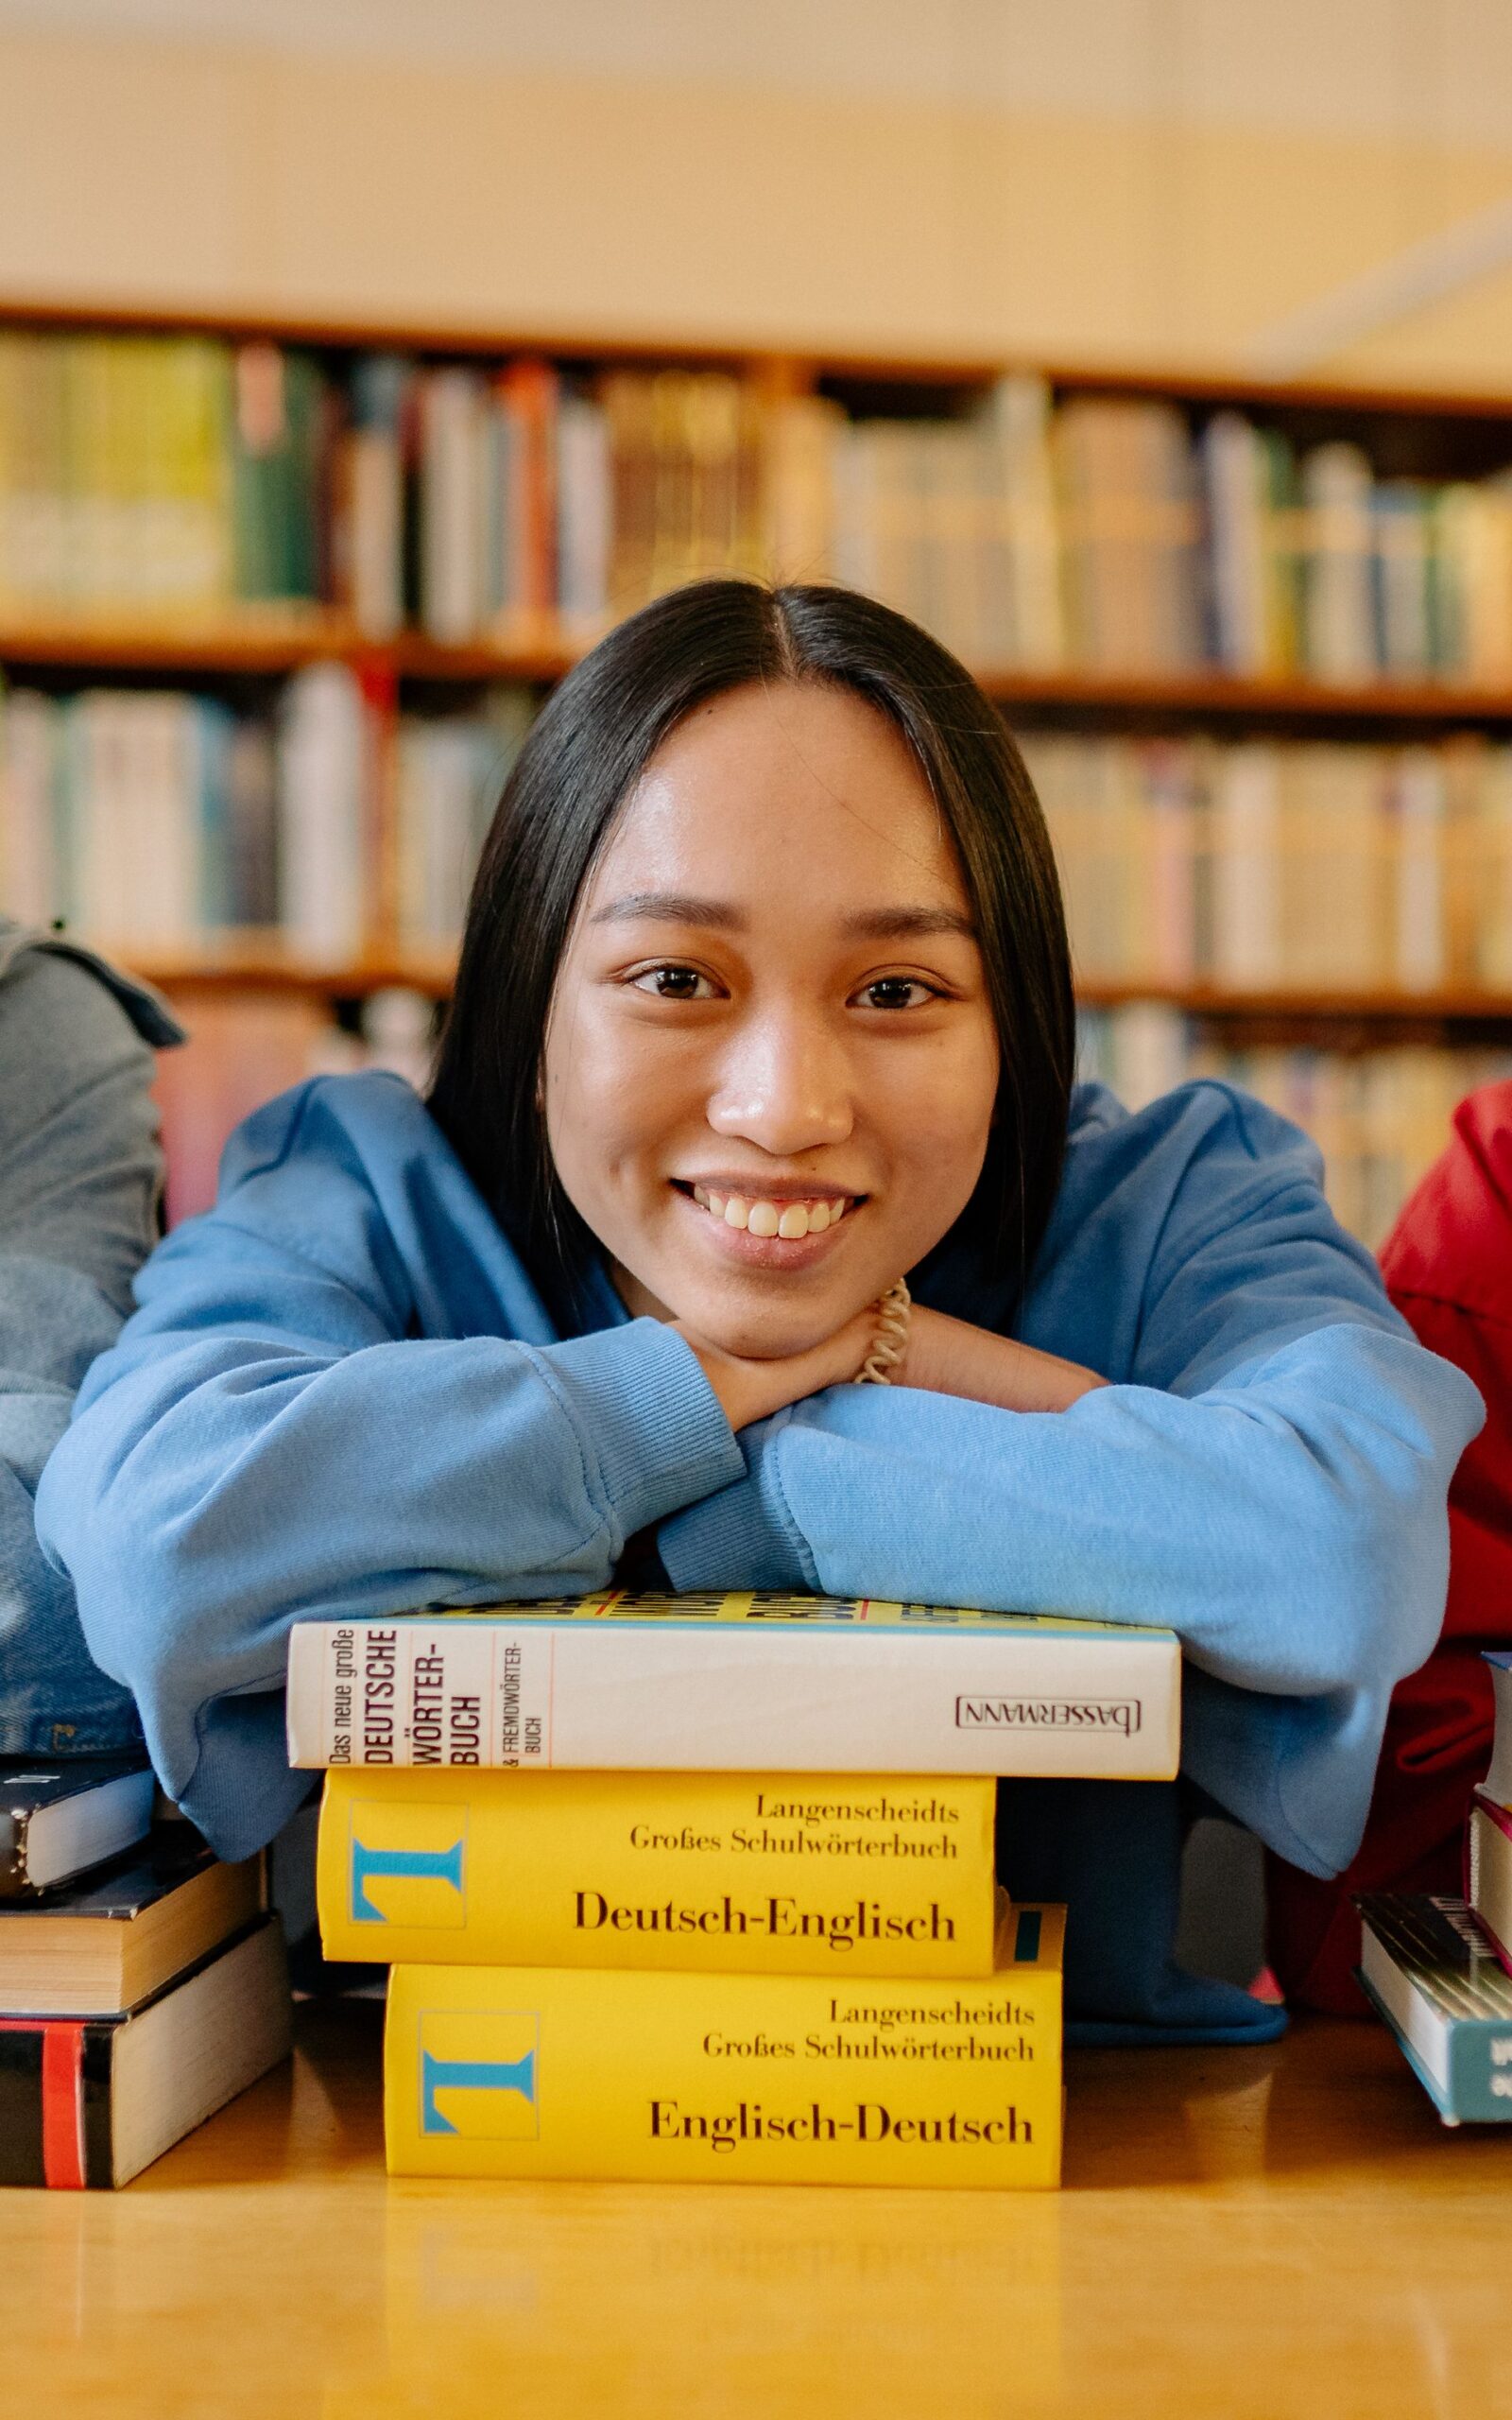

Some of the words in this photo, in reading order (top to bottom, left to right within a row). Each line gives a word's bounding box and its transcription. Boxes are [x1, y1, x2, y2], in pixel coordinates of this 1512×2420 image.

[332, 1629, 357, 1679] große
[335, 1685, 352, 1727] neue
[364, 1630, 397, 1765] DEUTSCHE
[404, 1643, 444, 1766] WÖRTER-
[499, 1642, 521, 1754] FREMDWÖRTER-
[329, 1735, 352, 1765] Das
[451, 1695, 480, 1766] BUCH
[525, 1717, 541, 1754] BUCH
[503, 1757, 519, 1768] &
[756, 1794, 960, 1828] Langenscheidts
[629, 1824, 722, 1852] Großes
[730, 1828, 958, 1859] Schulwörterbuch
[574, 1892, 956, 1952] Deutsch-Englisch
[829, 1999, 1036, 2033] Langenscheidts
[702, 2032, 796, 2059] Großes
[805, 2034, 1035, 2063] Schulwörterbuch
[647, 2100, 1036, 2154] Englisch-Deutsch
